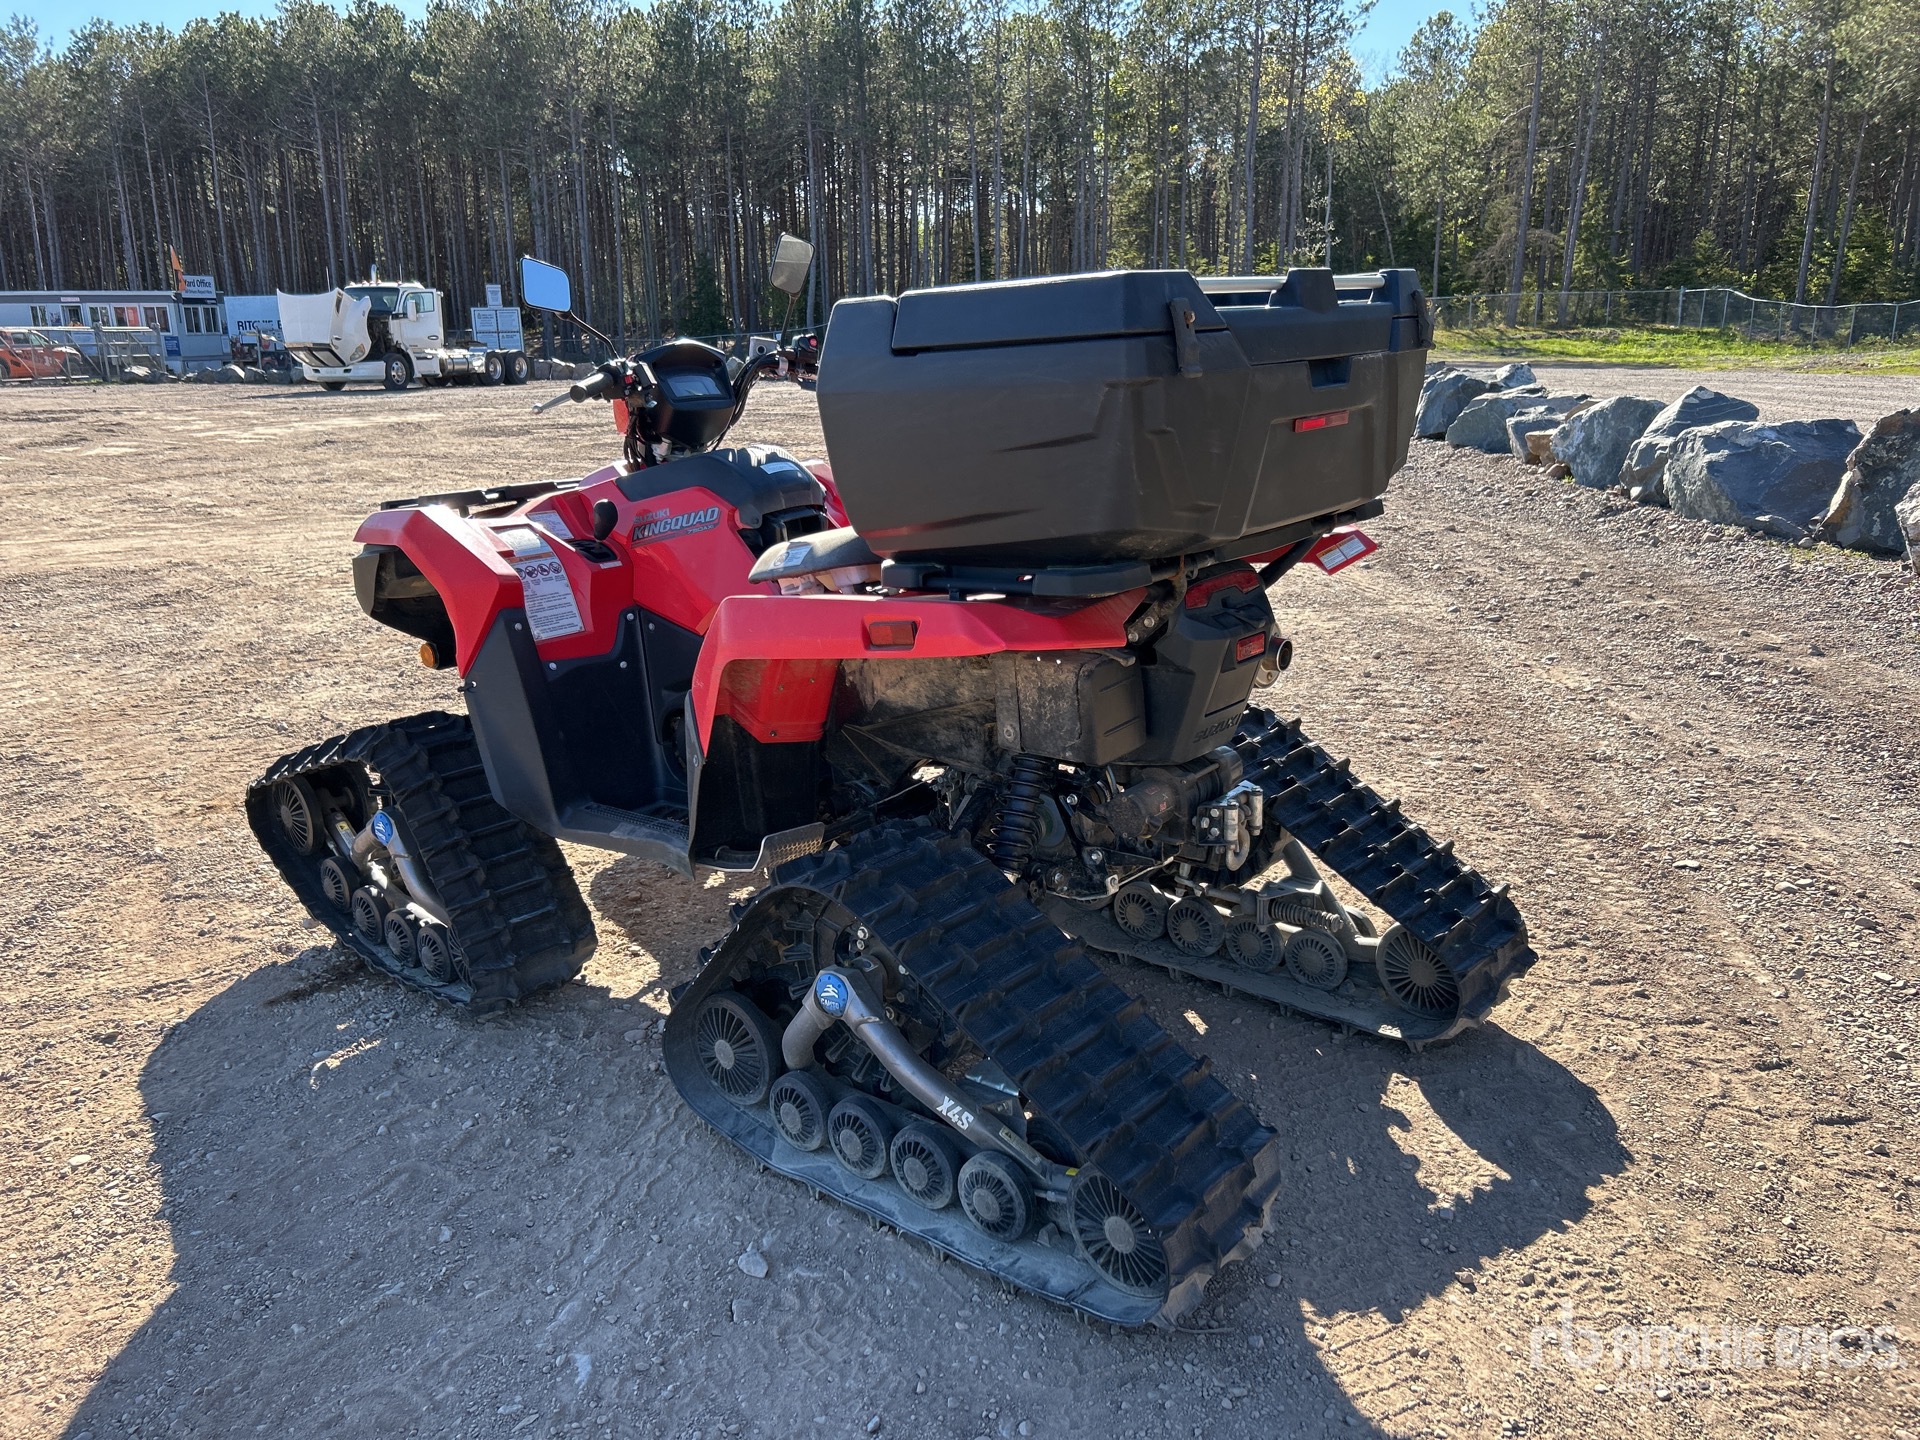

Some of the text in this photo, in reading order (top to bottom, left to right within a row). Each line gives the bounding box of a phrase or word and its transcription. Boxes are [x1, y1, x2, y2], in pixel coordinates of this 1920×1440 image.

[196, 279, 212, 288] Office
[237, 320, 273, 331] RITC
[632, 506, 720, 542] KINGQUAD
[633, 508, 670, 525] SUZUKI
[1192, 713, 1243, 744] SUZUKI
[936, 1095, 974, 1131] X4S
